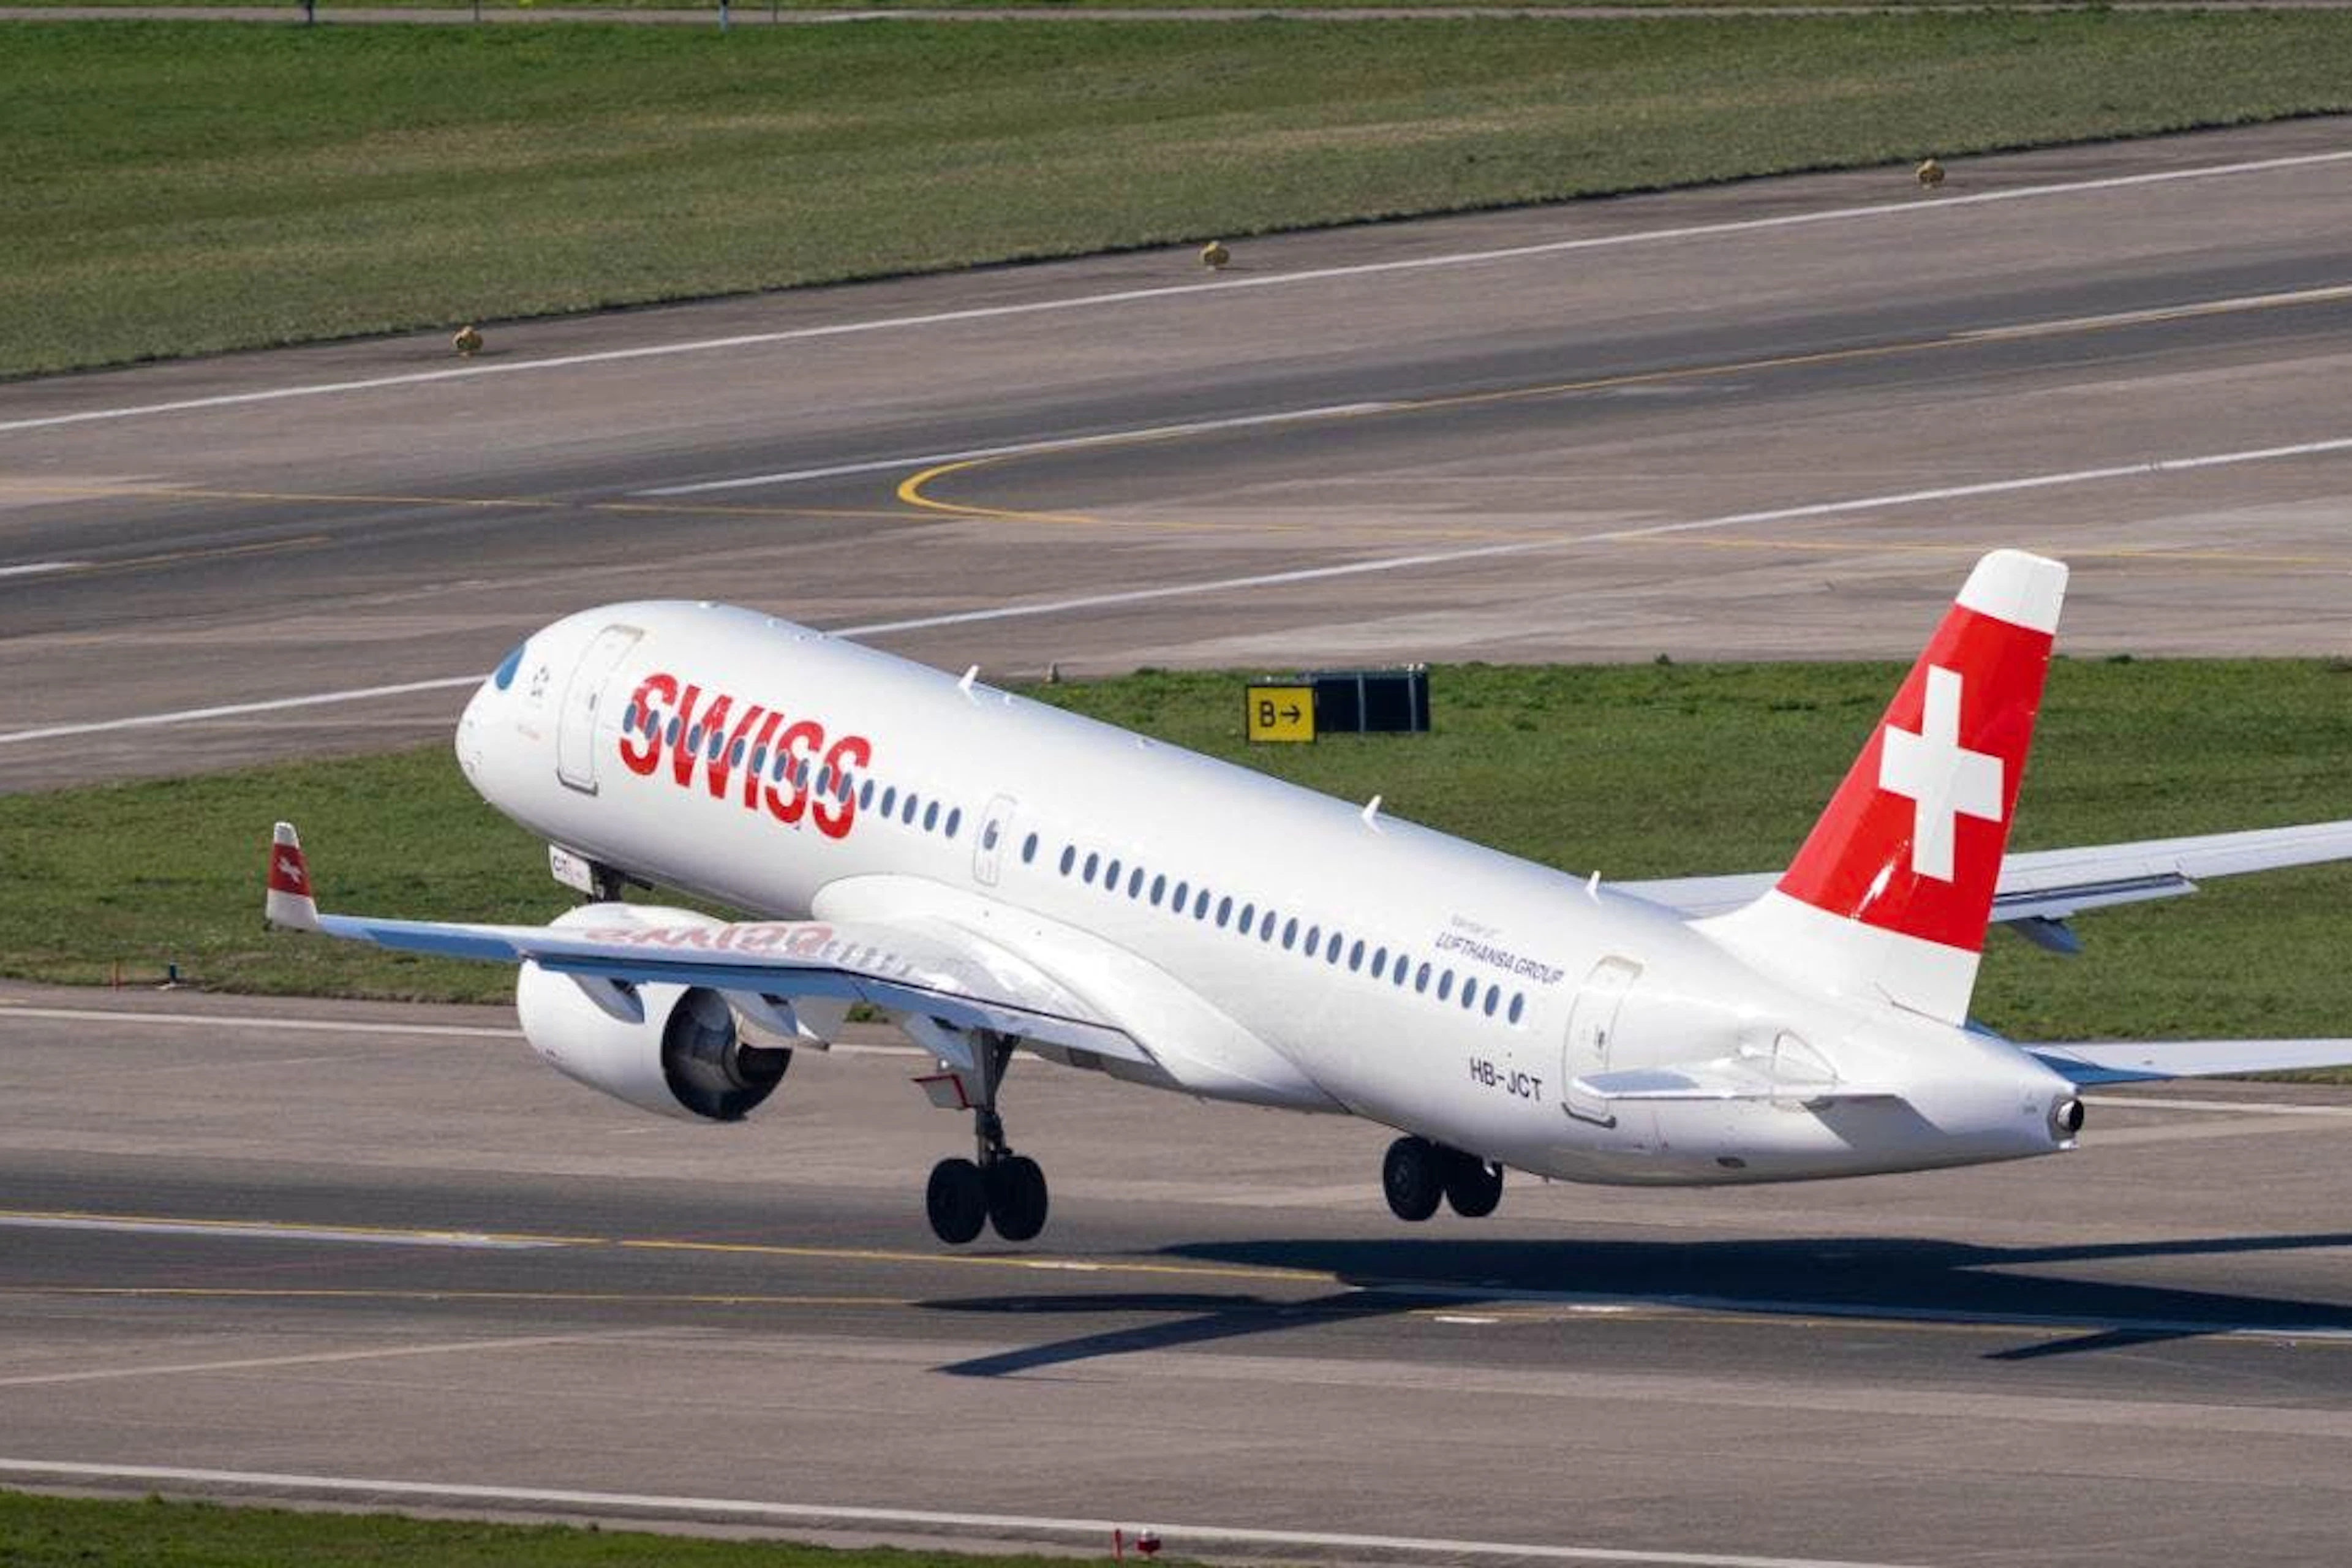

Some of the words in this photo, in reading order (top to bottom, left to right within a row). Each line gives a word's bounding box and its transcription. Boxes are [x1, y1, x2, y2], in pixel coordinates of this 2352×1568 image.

[1260, 701, 1276, 727] B
[620, 674, 871, 839] SWISS
[1436, 932, 1515, 971] LUFTHANSA
[1515, 958, 1564, 984] GROUP
[1470, 1057, 1542, 1101] HB-JCT
